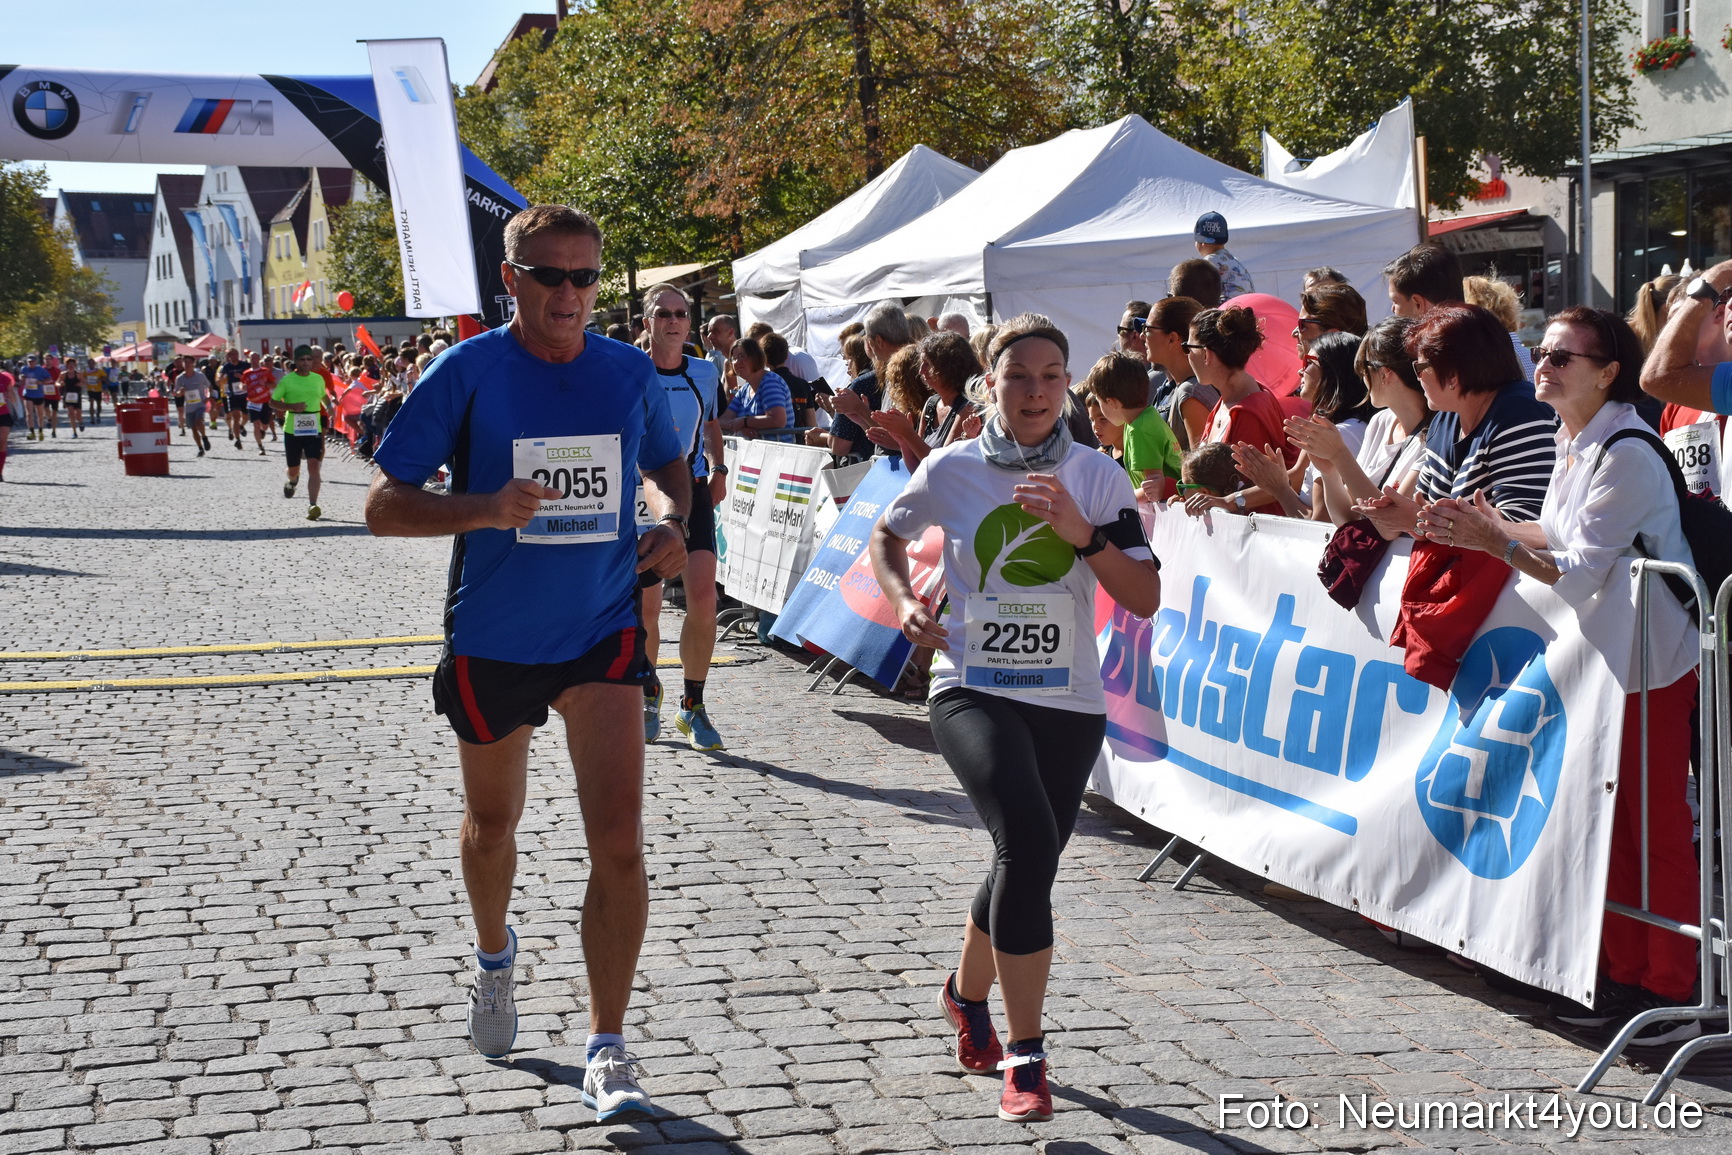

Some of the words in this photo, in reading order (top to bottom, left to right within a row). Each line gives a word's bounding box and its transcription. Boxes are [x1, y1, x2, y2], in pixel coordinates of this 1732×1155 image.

[18, 80, 72, 100] BMW
[546, 446, 592, 459] BOCK
[531, 466, 608, 500] 2055
[564, 503, 596, 511] Neumarkt
[849, 501, 880, 519] STORE
[547, 517, 598, 533] Michael
[804, 567, 841, 591] OBILE
[845, 571, 882, 598] SPORTS
[998, 604, 1047, 614] BOCK
[981, 622, 1060, 654] 2259
[994, 671, 1043, 686] Corinna
